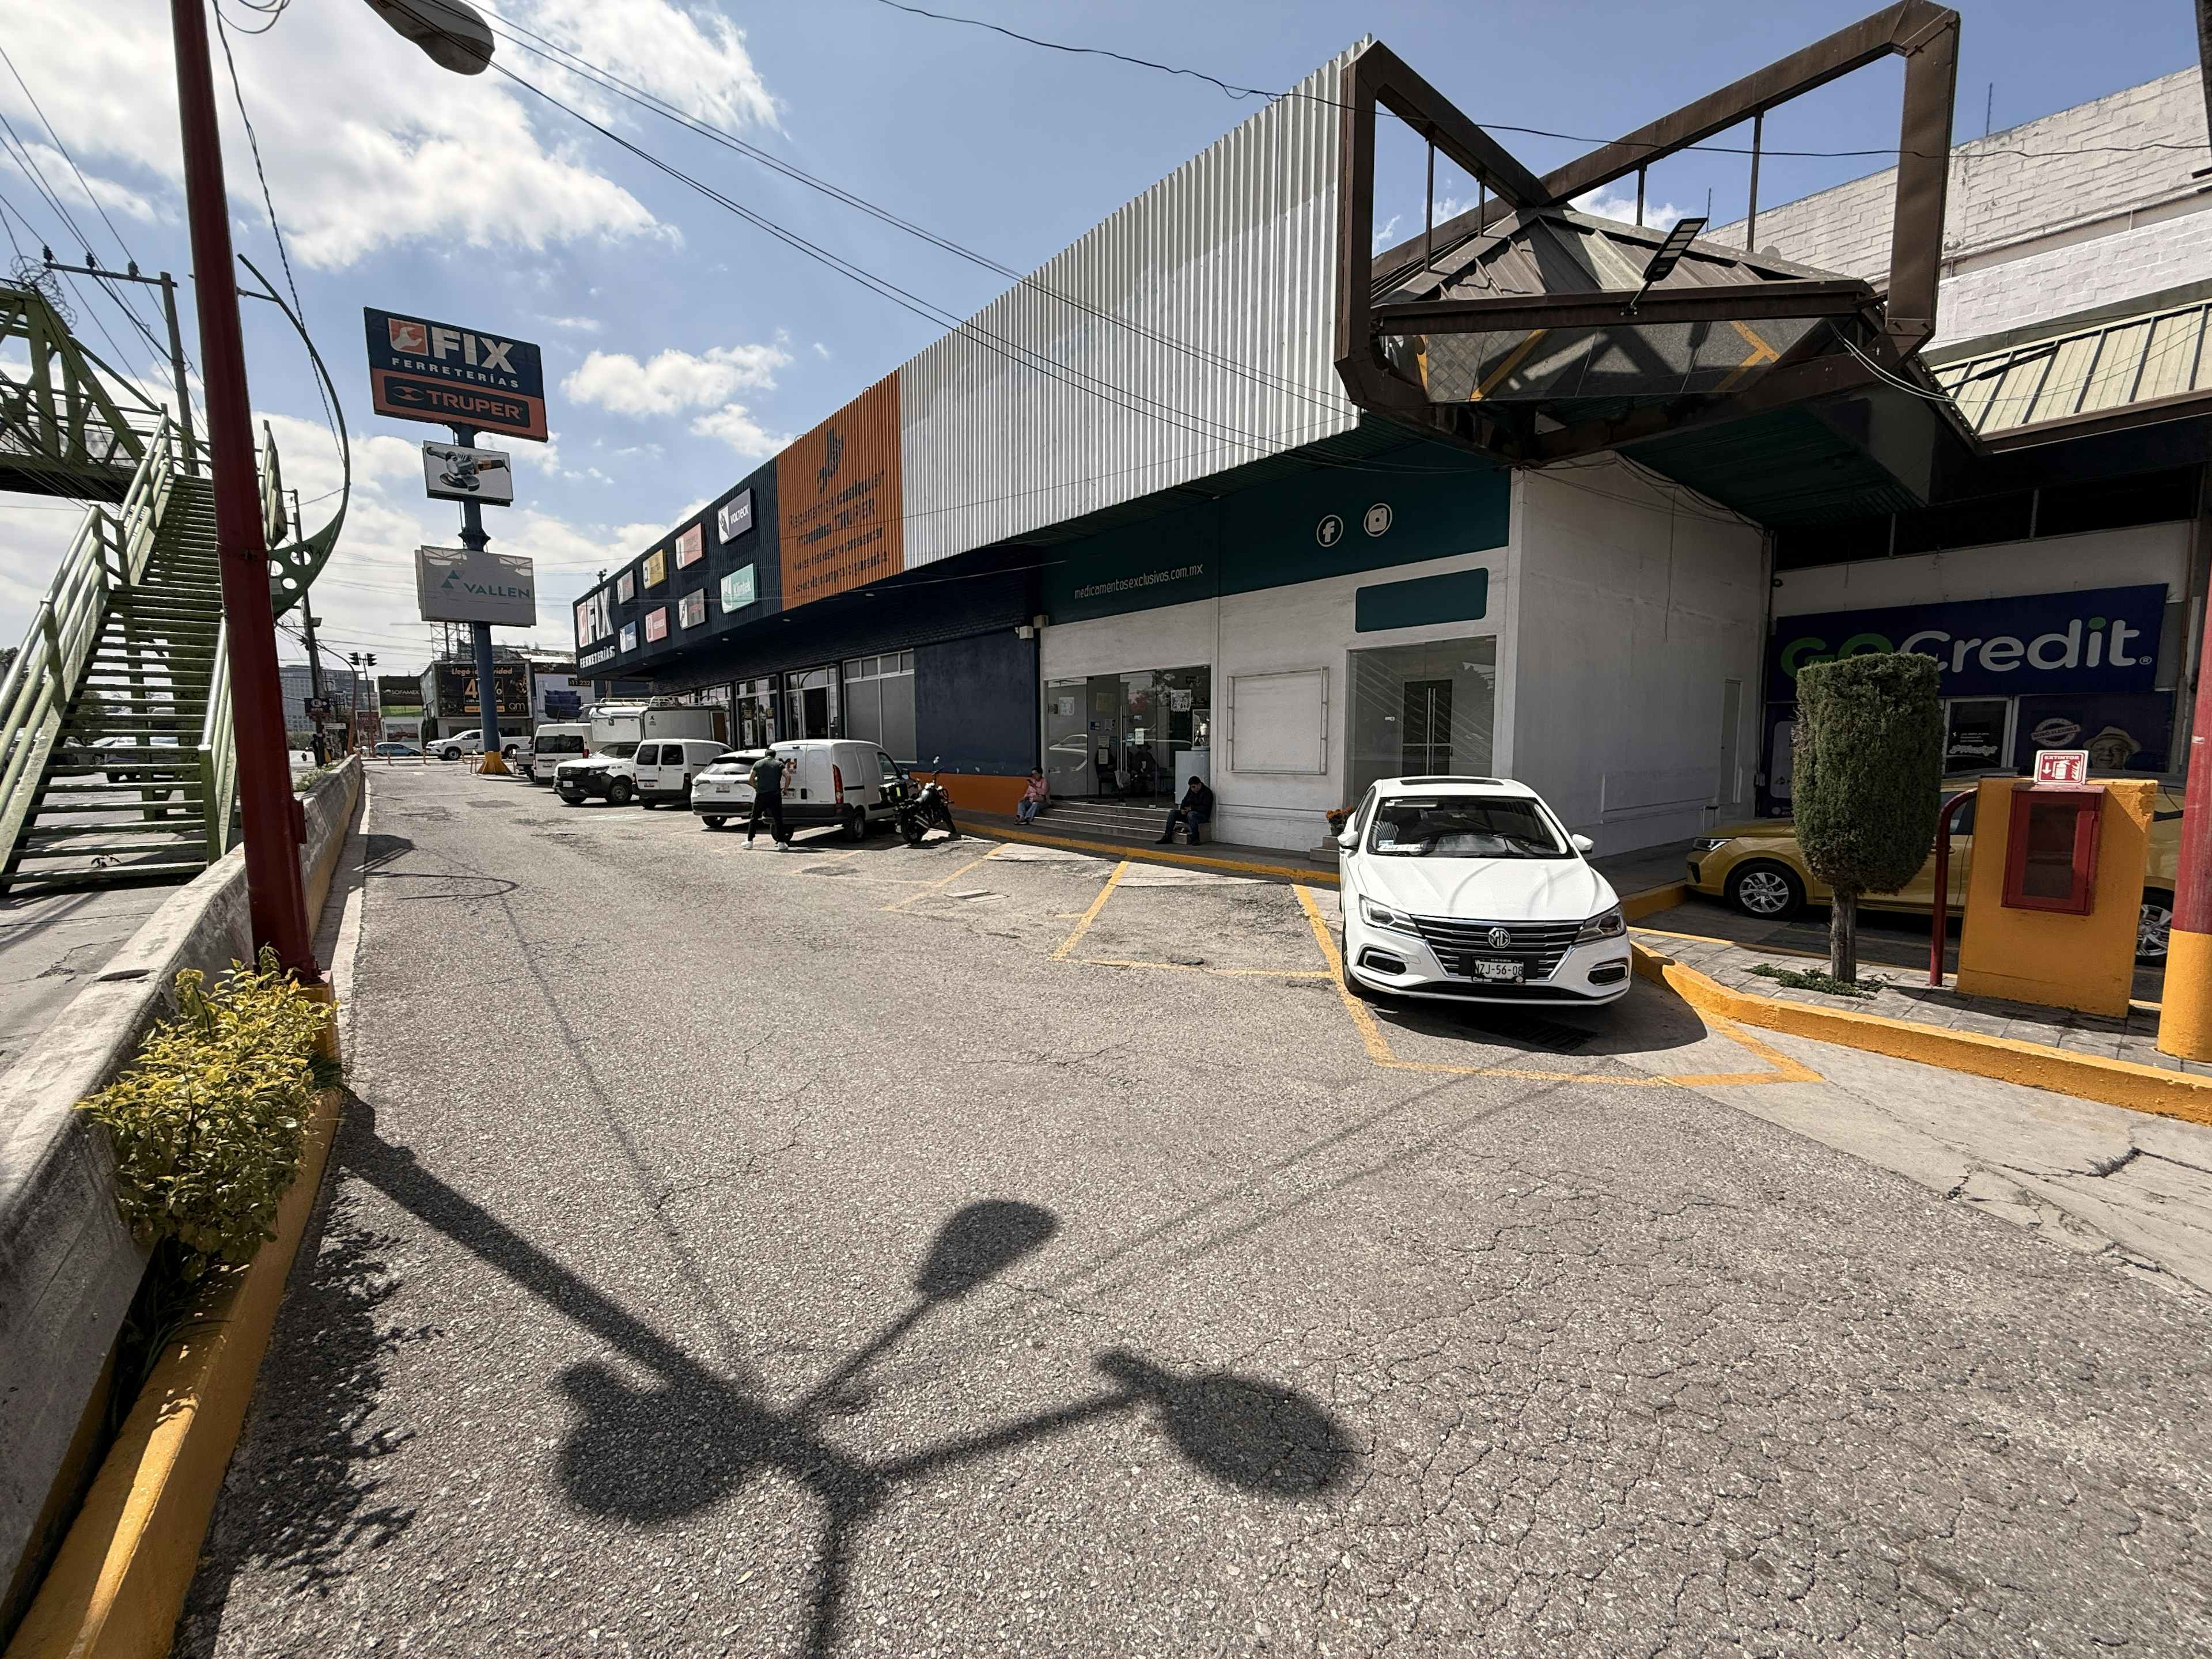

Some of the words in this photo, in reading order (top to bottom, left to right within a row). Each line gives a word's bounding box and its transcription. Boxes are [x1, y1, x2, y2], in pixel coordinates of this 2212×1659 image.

[431, 326, 517, 374] FIX
[392, 357, 519, 388] FERRETERÍAS
[426, 390, 521, 419] TRUPER
[463, 582, 530, 599] VALLEN
[1075, 564, 1203, 599] medicamentosexclusivos.com.mx
[586, 586, 614, 645] FIX
[579, 646, 615, 669] FERRETERÍAS
